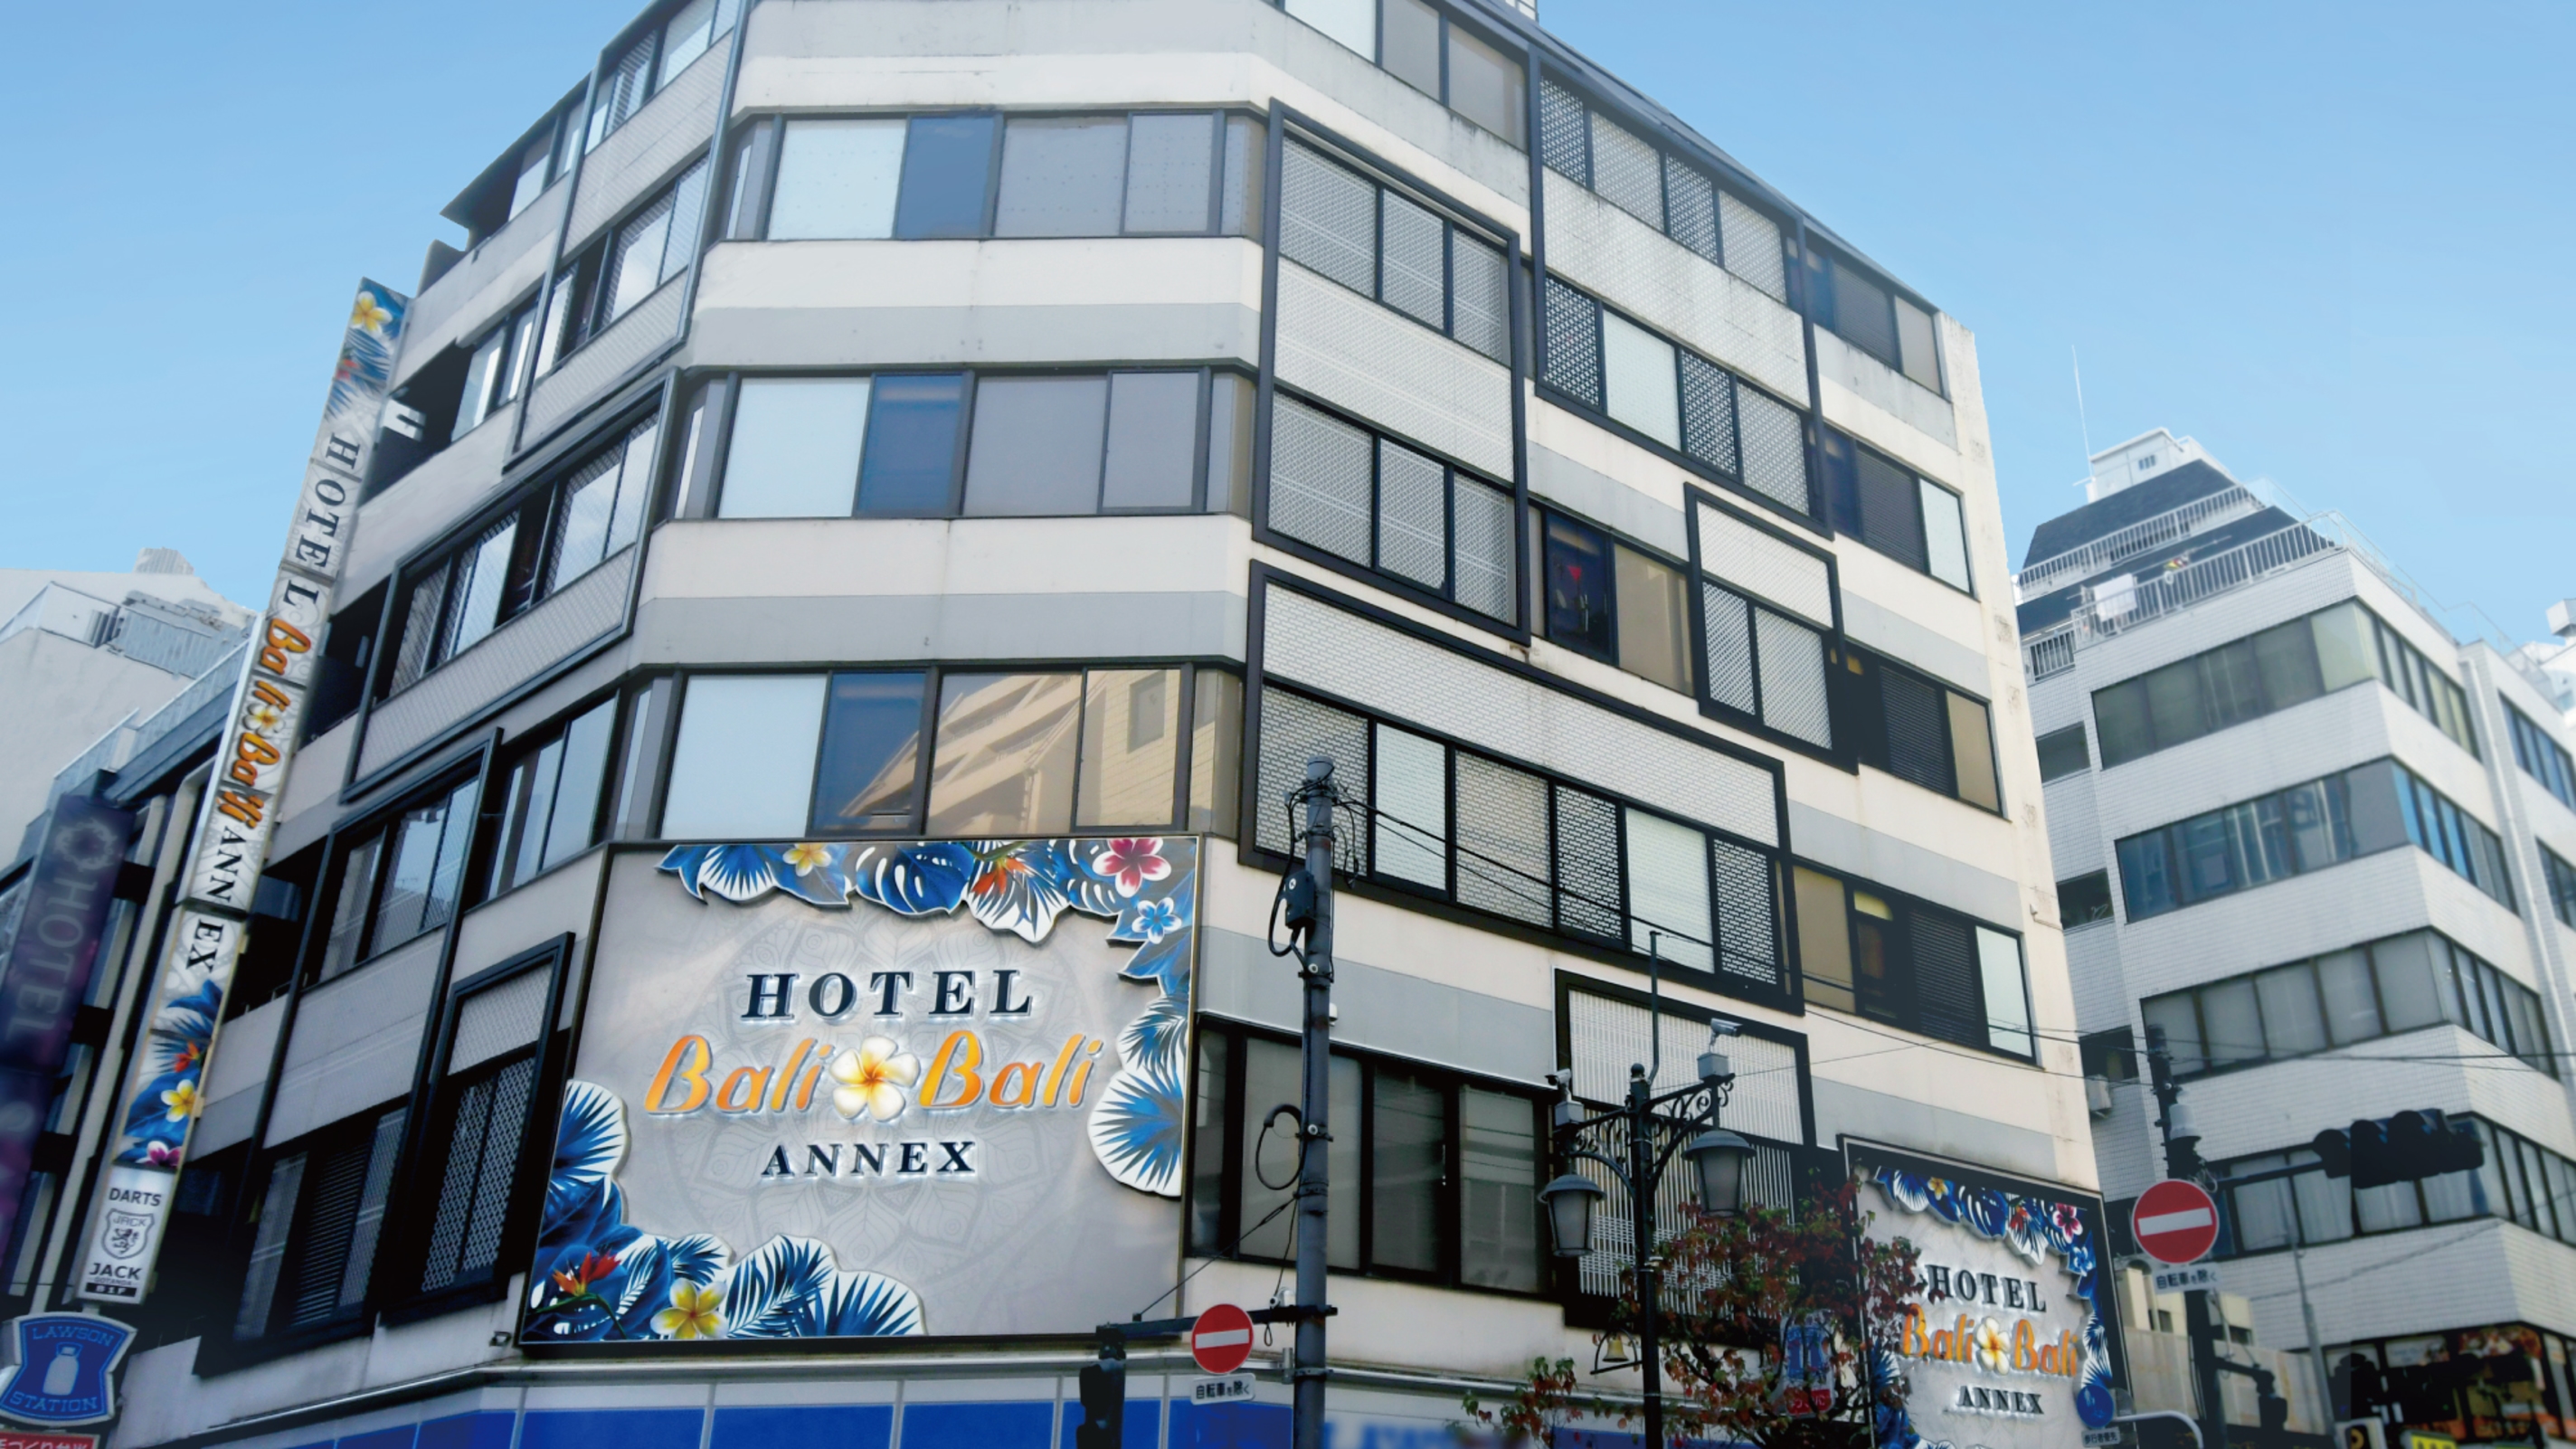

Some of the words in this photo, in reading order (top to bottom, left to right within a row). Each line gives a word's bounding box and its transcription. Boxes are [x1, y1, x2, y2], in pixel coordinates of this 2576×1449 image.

[282, 431, 361, 605] HOTEL
[254, 617, 311, 712] Bali
[215, 733, 280, 828] Bali
[185, 826, 247, 974] ANNEX
[5, 876, 99, 1040] HOTEL
[741, 968, 1034, 1019] HOTEL
[645, 1034, 833, 1114] Bali
[920, 1029, 1102, 1110] Bali
[762, 1141, 976, 1177] ANNEX
[109, 1188, 162, 1207] DARTS
[113, 1217, 147, 1227] JACK
[89, 1263, 142, 1281] JACK
[95, 1284, 127, 1294] B1F
[1924, 1264, 2047, 1312] HOTEL
[2155, 1268, 2217, 1290] 自転車を除く
[32, 1326, 114, 1347] LAWSON
[1902, 1303, 1975, 1364] Bali
[2013, 1319, 2079, 1377] Bali
[9, 1390, 99, 1413] STATION
[1196, 1379, 1250, 1399] 自転車を除く
[1956, 1385, 2045, 1415] ANNEX
